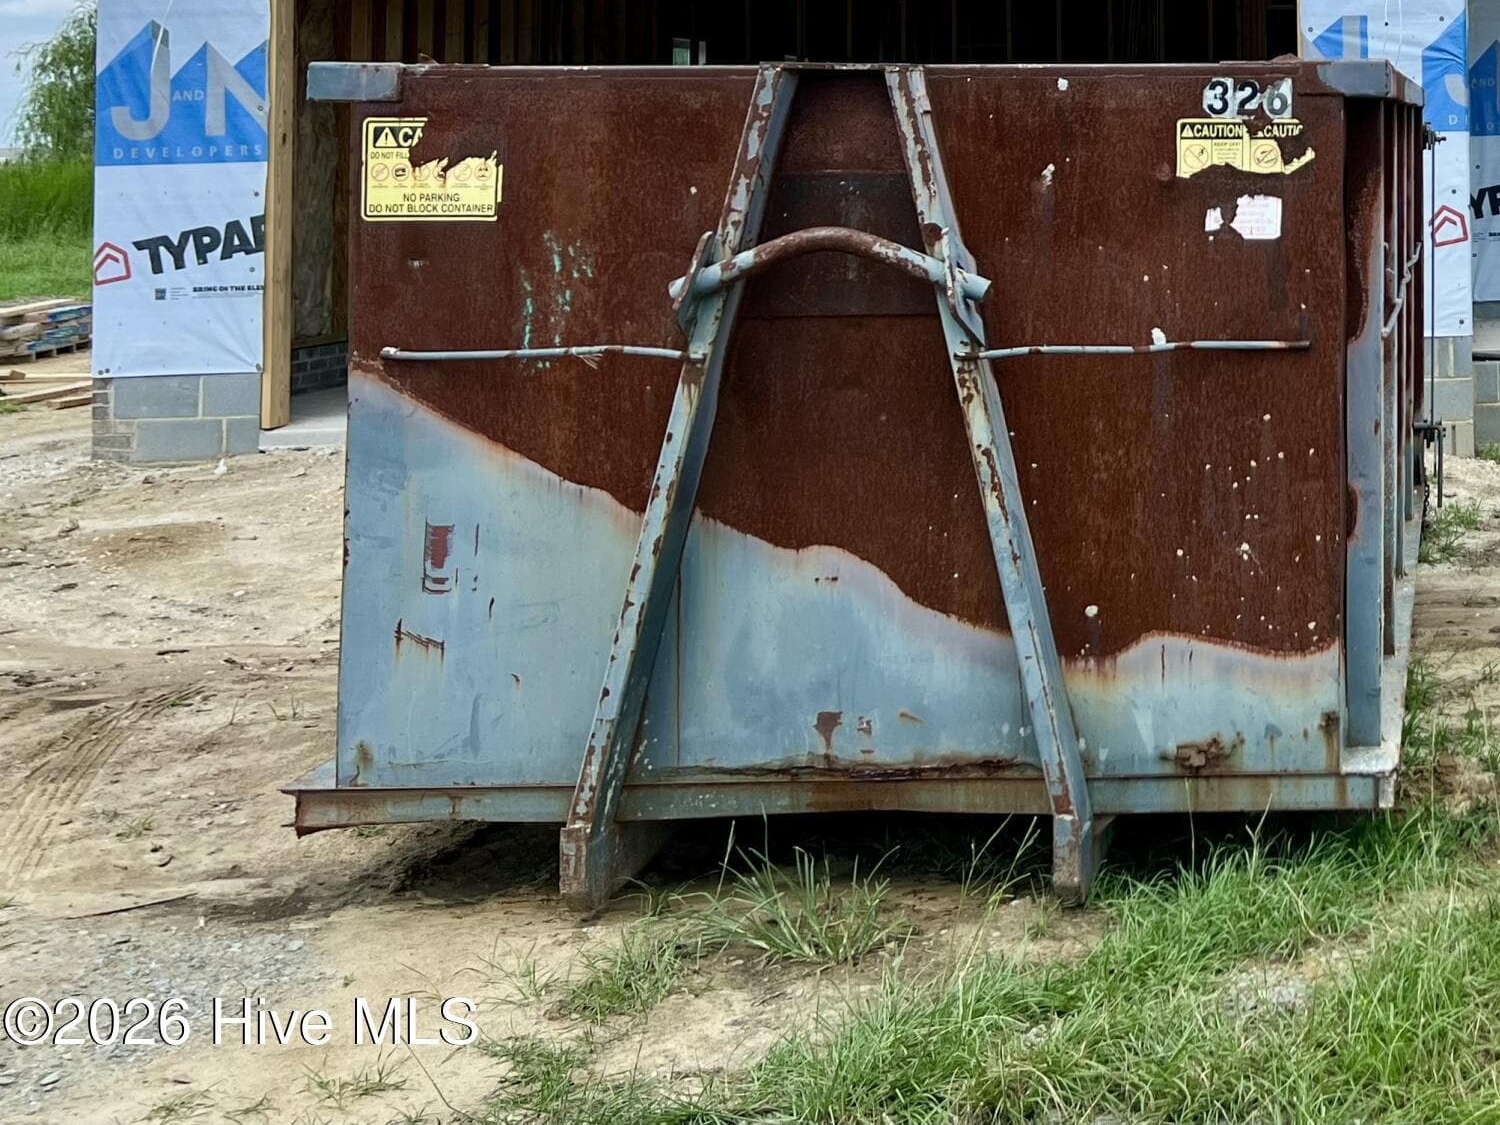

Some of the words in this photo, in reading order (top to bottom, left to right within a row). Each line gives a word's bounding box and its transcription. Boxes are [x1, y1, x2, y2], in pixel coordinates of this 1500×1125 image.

[111, 19, 171, 141] J
[172, 90, 205, 101] AND
[1207, 80, 1289, 116] 326
[1193, 124, 1243, 138] CAUTION
[112, 144, 264, 160] DEVELOPERS
[370, 151, 380, 159] DO
[381, 151, 394, 159] NOT
[403, 193, 417, 203] NO
[419, 193, 460, 203] PARKING
[369, 204, 383, 213] DO
[385, 204, 404, 213] NOT
[407, 204, 439, 213] BLOCK
[441, 204, 493, 213] CONTAINER
[132, 214, 265, 275] TYPA
